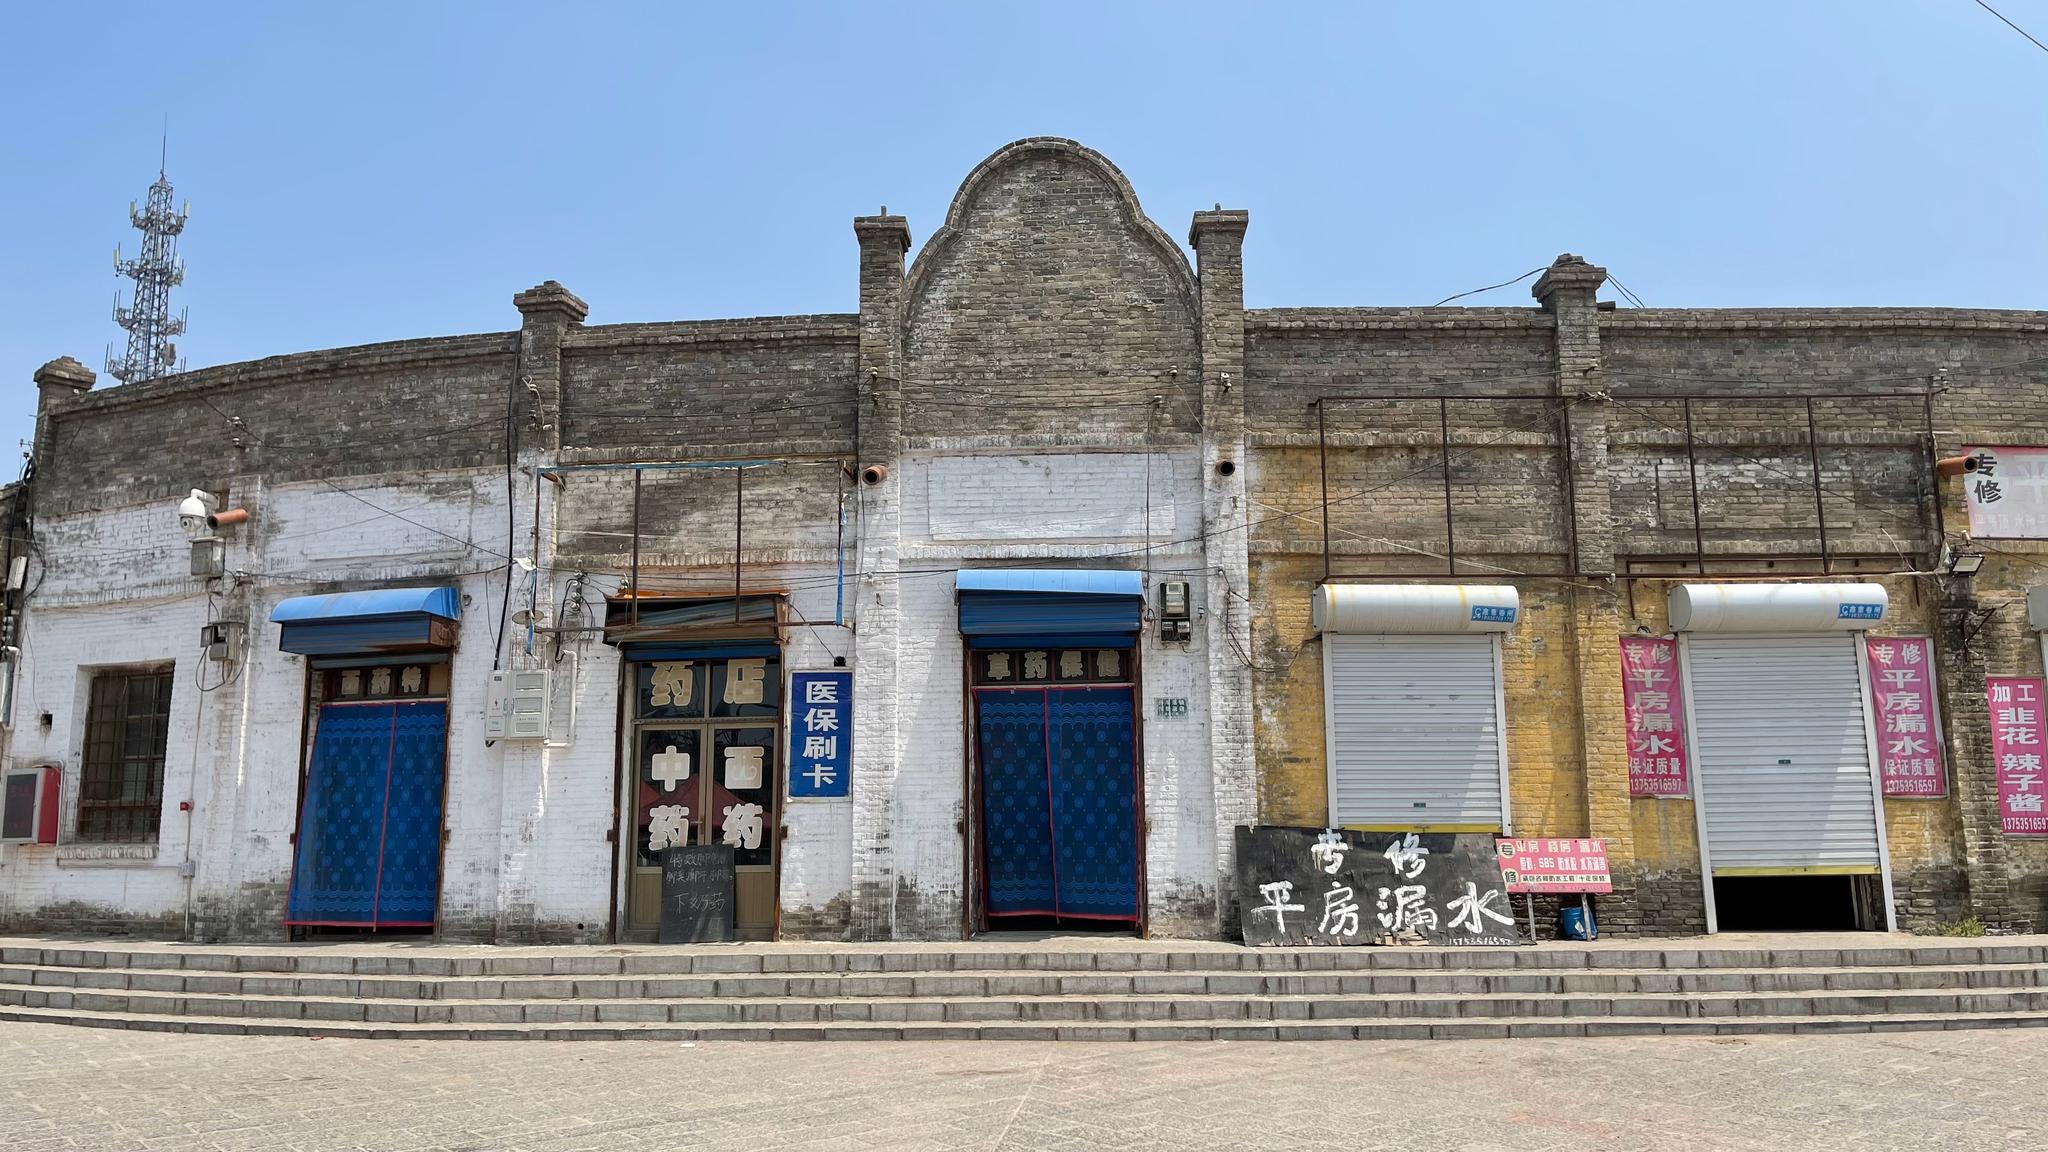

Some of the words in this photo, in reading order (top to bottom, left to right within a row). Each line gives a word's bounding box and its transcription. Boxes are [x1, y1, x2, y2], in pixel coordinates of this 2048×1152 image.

[1974, 453, 2002, 504] 专修
[1625, 643, 1673, 664] 专修
[1875, 643, 1921, 665] 专修
[650, 659, 766, 706] 药店
[1992, 682, 2036, 703] 加工
[1628, 668, 1676, 754] 平房漏水
[1880, 669, 1929, 756] 平房漏水
[802, 681, 839, 789] 医保刷卡
[1630, 757, 1681, 775] 保证质量
[1885, 758, 1936, 777] 保证质量
[1630, 778, 1681, 792] 13753516597
[1886, 779, 1937, 792] 13753516597
[2001, 753, 2045, 812] 辣子酱
[1538, 858, 1555, 868] SBS
[1250, 880, 1515, 935] 平房漏水
